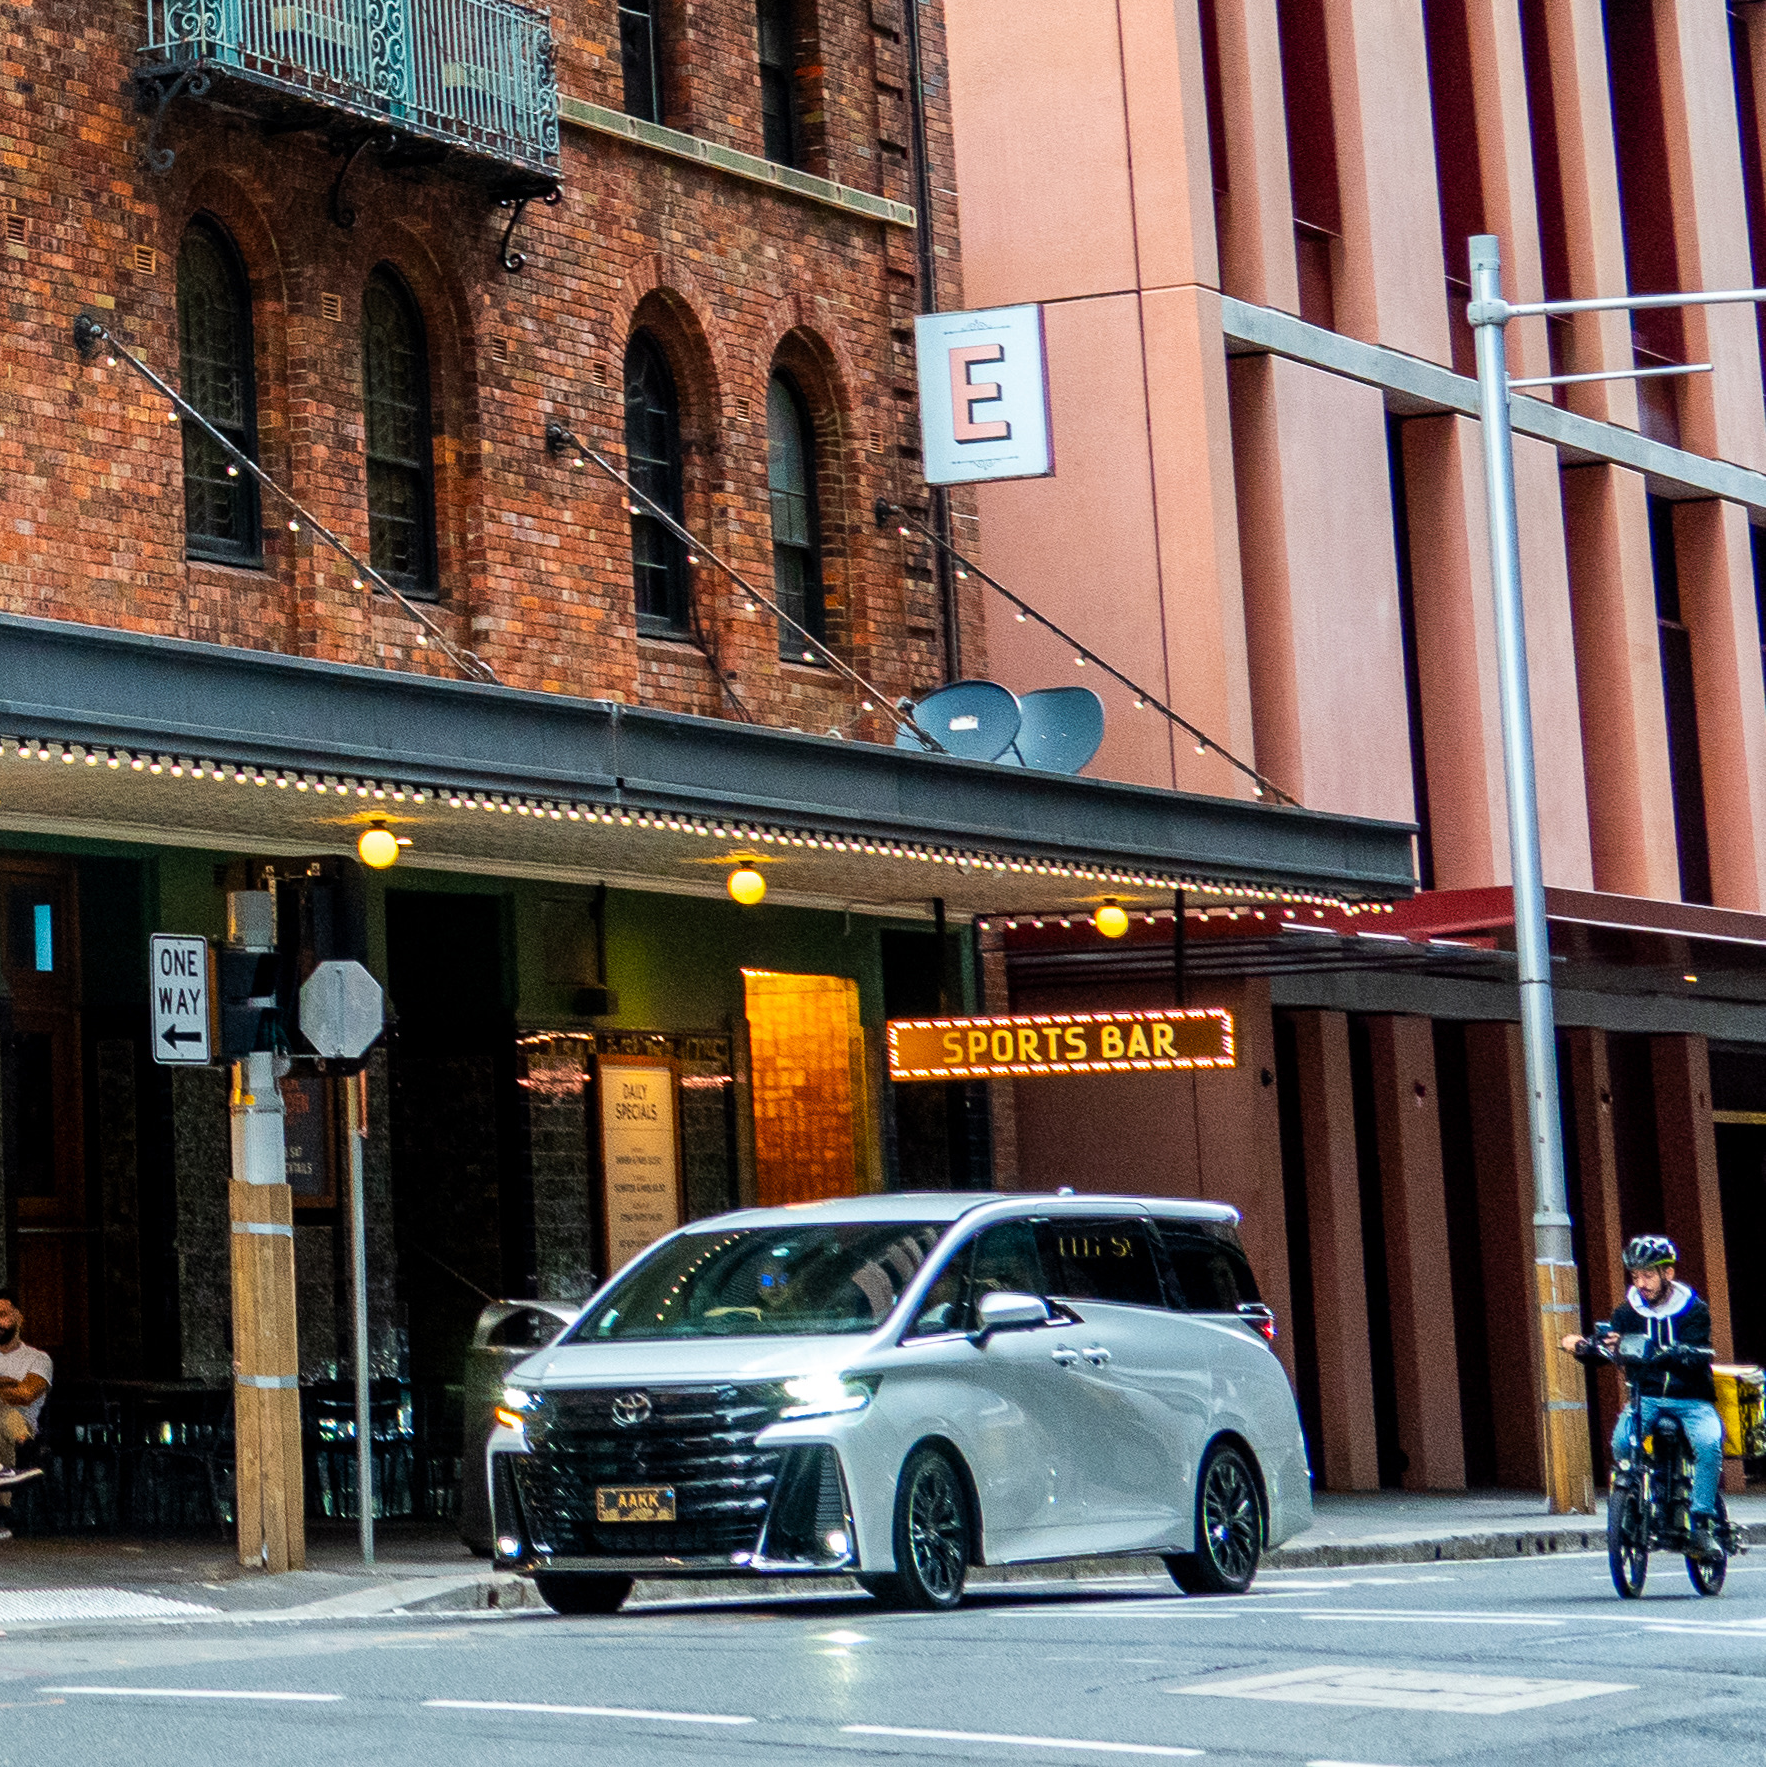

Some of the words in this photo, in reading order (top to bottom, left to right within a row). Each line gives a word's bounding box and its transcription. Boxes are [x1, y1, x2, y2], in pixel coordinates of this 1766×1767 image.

[949, 344, 1012, 445] E
[161, 948, 198, 977] ONE
[159, 987, 201, 1015] WAY
[942, 1026, 1087, 1064] SPORTS
[1100, 1022, 1179, 1059] BAR
[615, 1103, 658, 1121] SPECIALS
